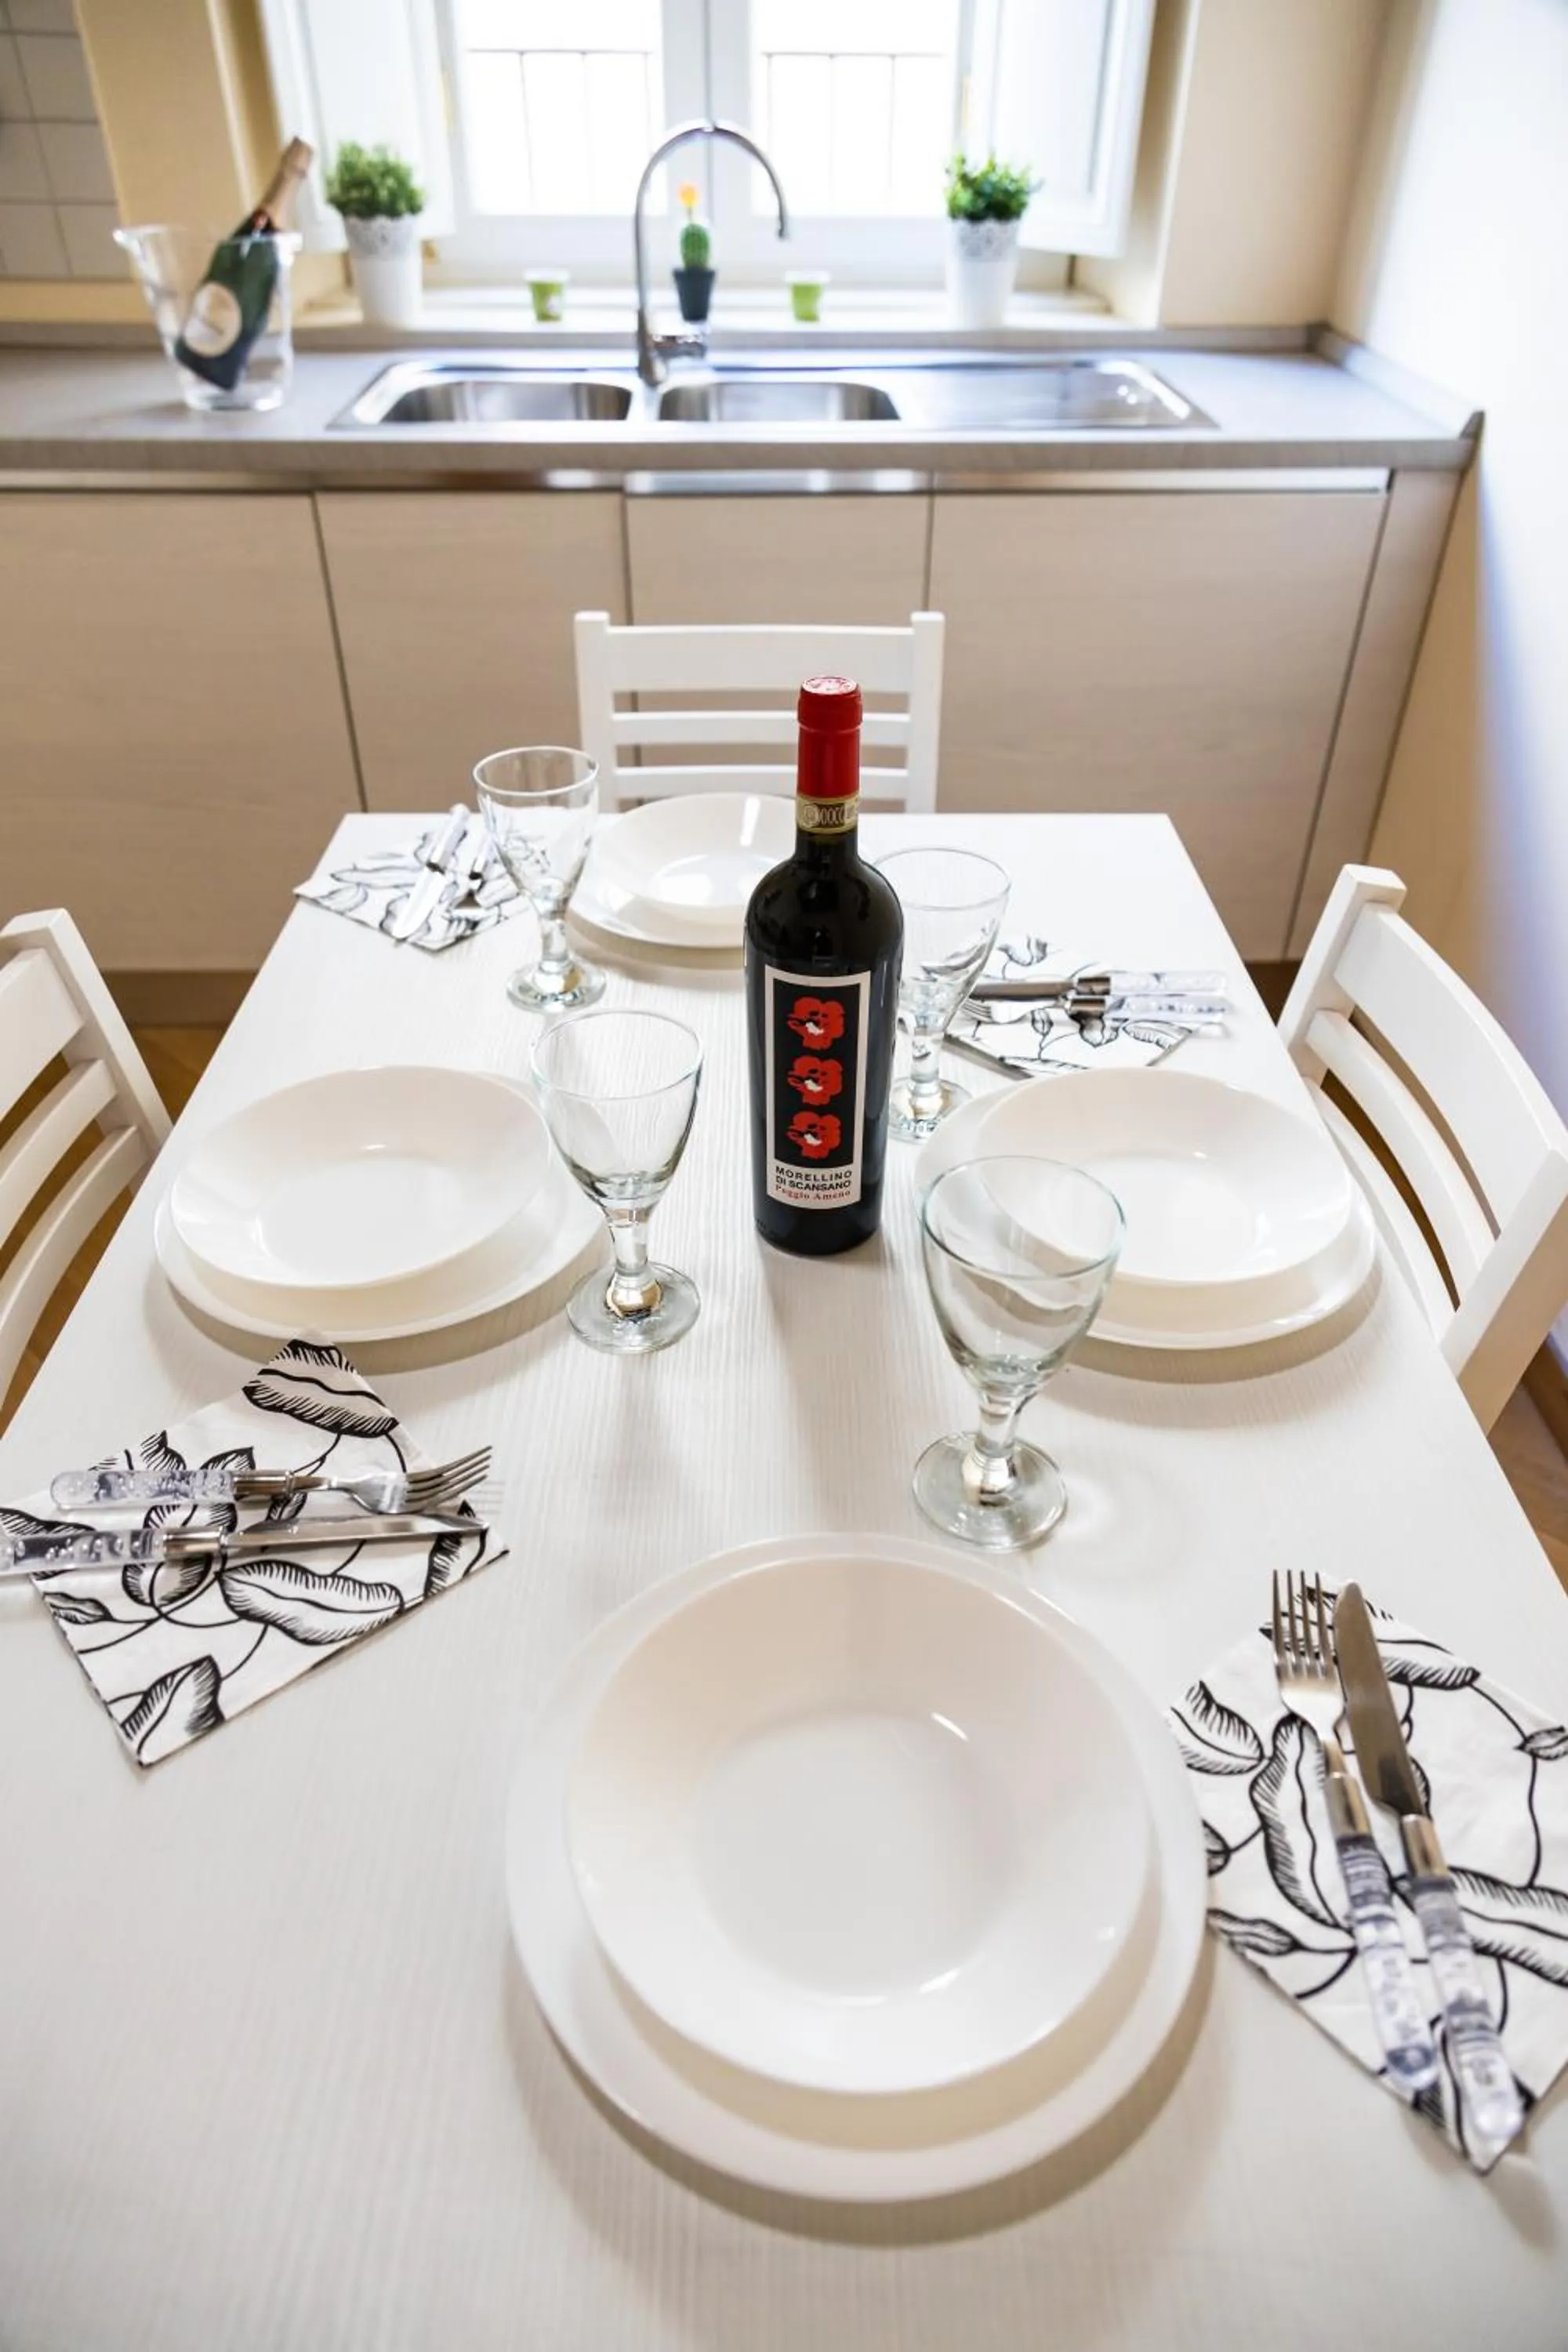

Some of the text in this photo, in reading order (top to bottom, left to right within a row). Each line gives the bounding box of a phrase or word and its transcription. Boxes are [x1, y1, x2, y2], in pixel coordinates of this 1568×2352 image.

[775, 1166, 852, 1181] MORELLINO
[775, 1176, 851, 1192] DI SCANSANO
[814, 1190, 851, 1200] Ameno
